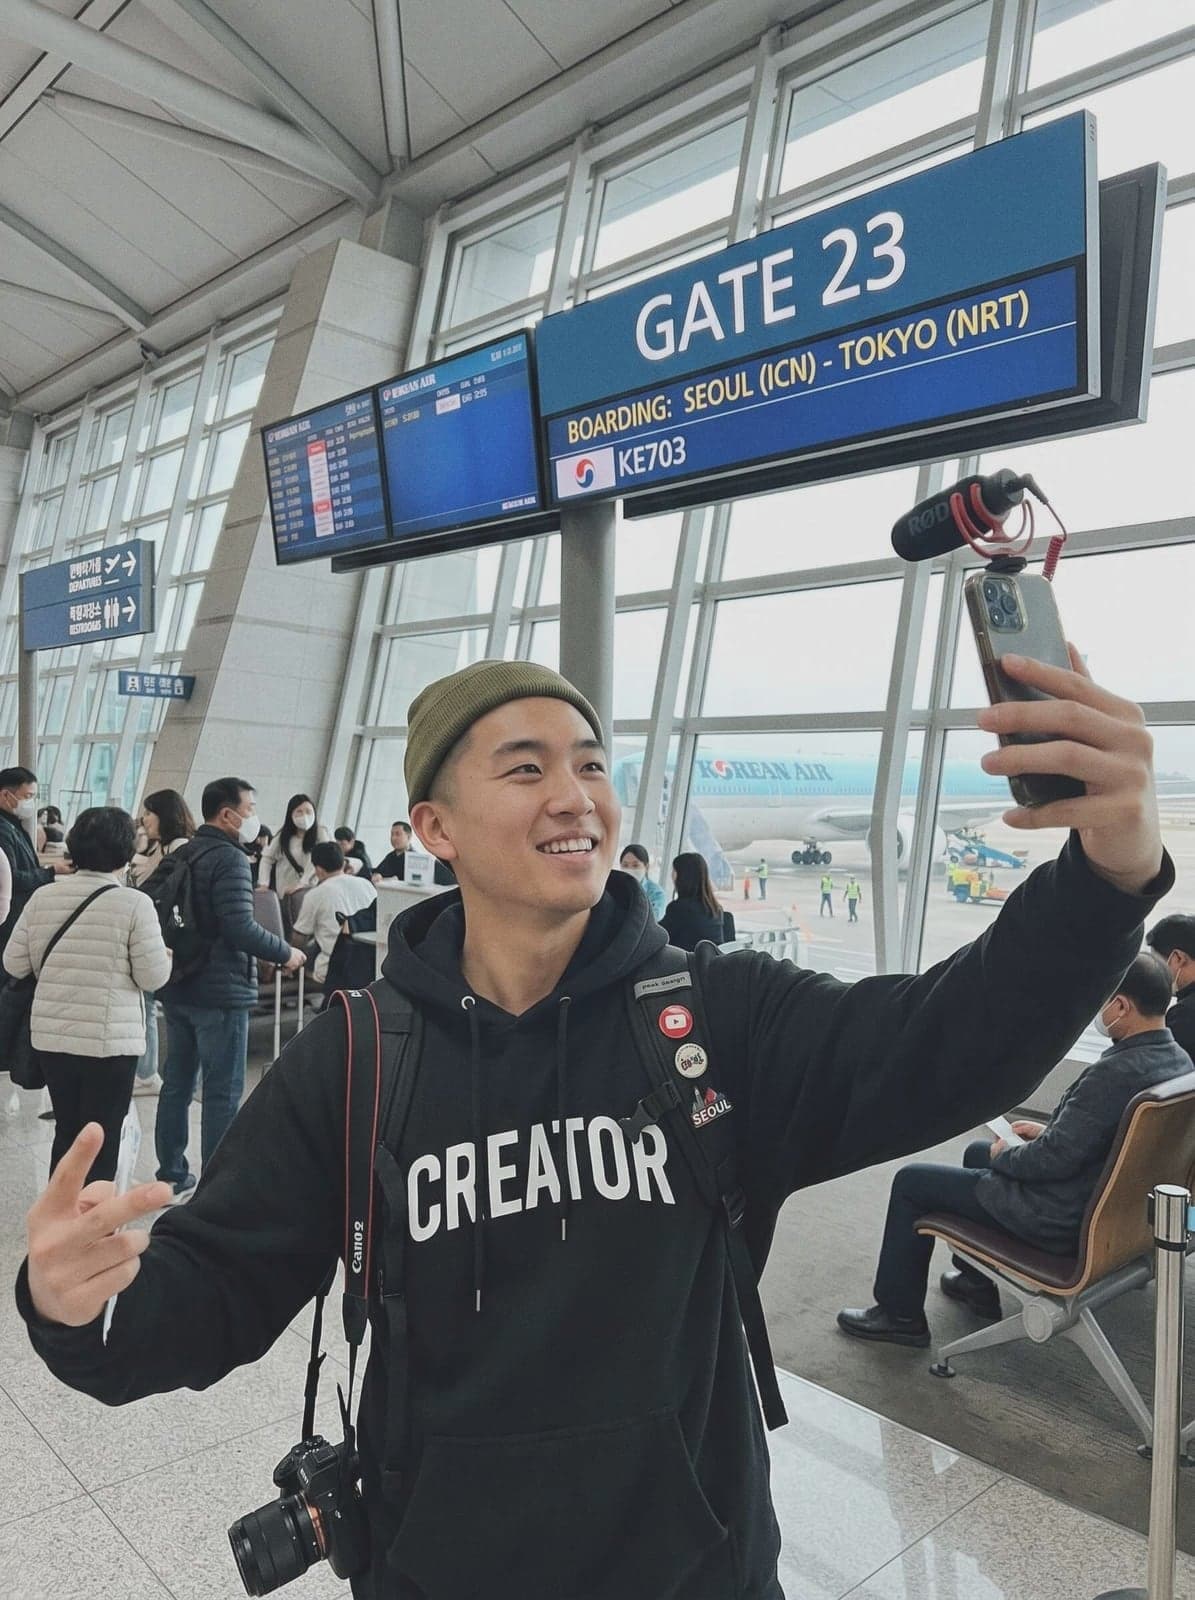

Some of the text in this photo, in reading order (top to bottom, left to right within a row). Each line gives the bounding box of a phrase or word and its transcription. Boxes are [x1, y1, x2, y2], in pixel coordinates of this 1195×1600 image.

[635, 210, 907, 361] GATE 23
[567, 395, 672, 444] BOARDING:
[684, 370, 754, 413] SEOUL
[759, 351, 816, 397] (ICN)
[838, 317, 937, 370] TOKYO
[946, 289, 1030, 347] (NRT)
[618, 436, 687, 478] KE703
[794, 761, 833, 782] AIR
[692, 1099, 731, 1126] SEOUL
[407, 1115, 676, 1243] CREATOR
